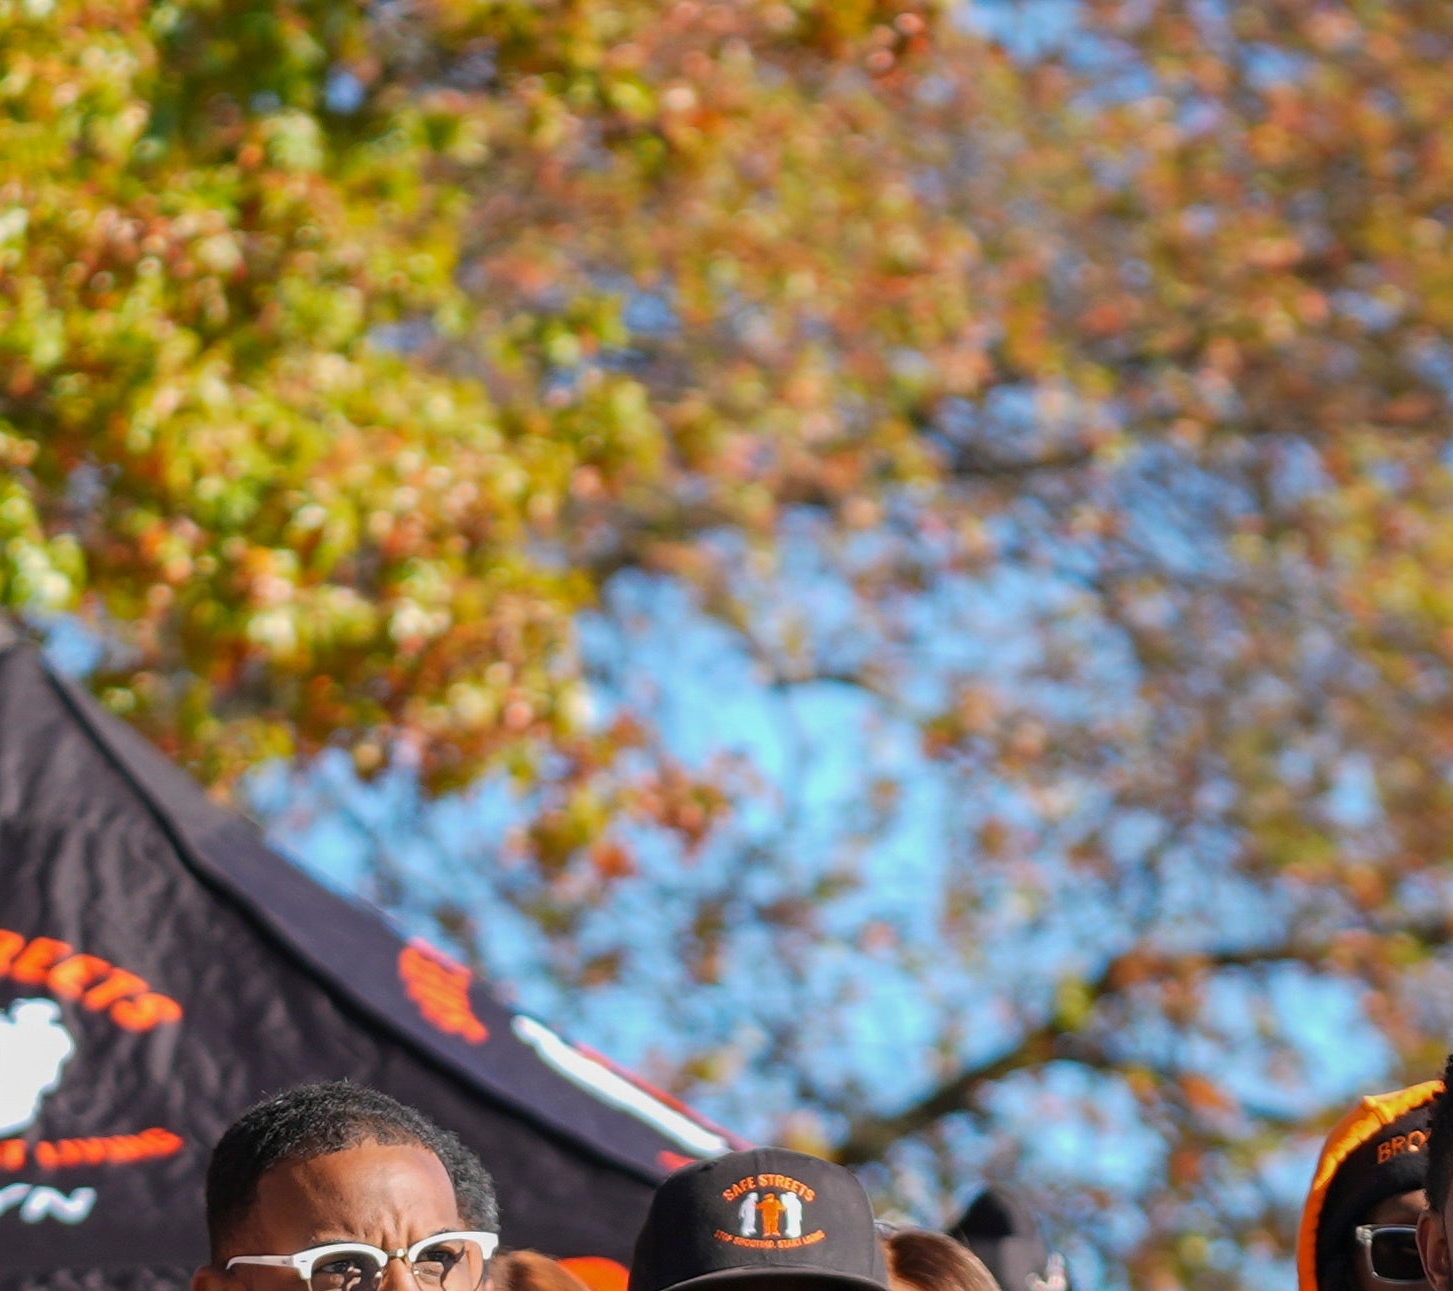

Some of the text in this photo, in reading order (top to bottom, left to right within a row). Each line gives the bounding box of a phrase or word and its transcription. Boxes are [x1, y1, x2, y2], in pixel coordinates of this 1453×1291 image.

[1377, 1127, 1433, 1164] BRO
[721, 1173, 816, 1202] SAFE STREETS
